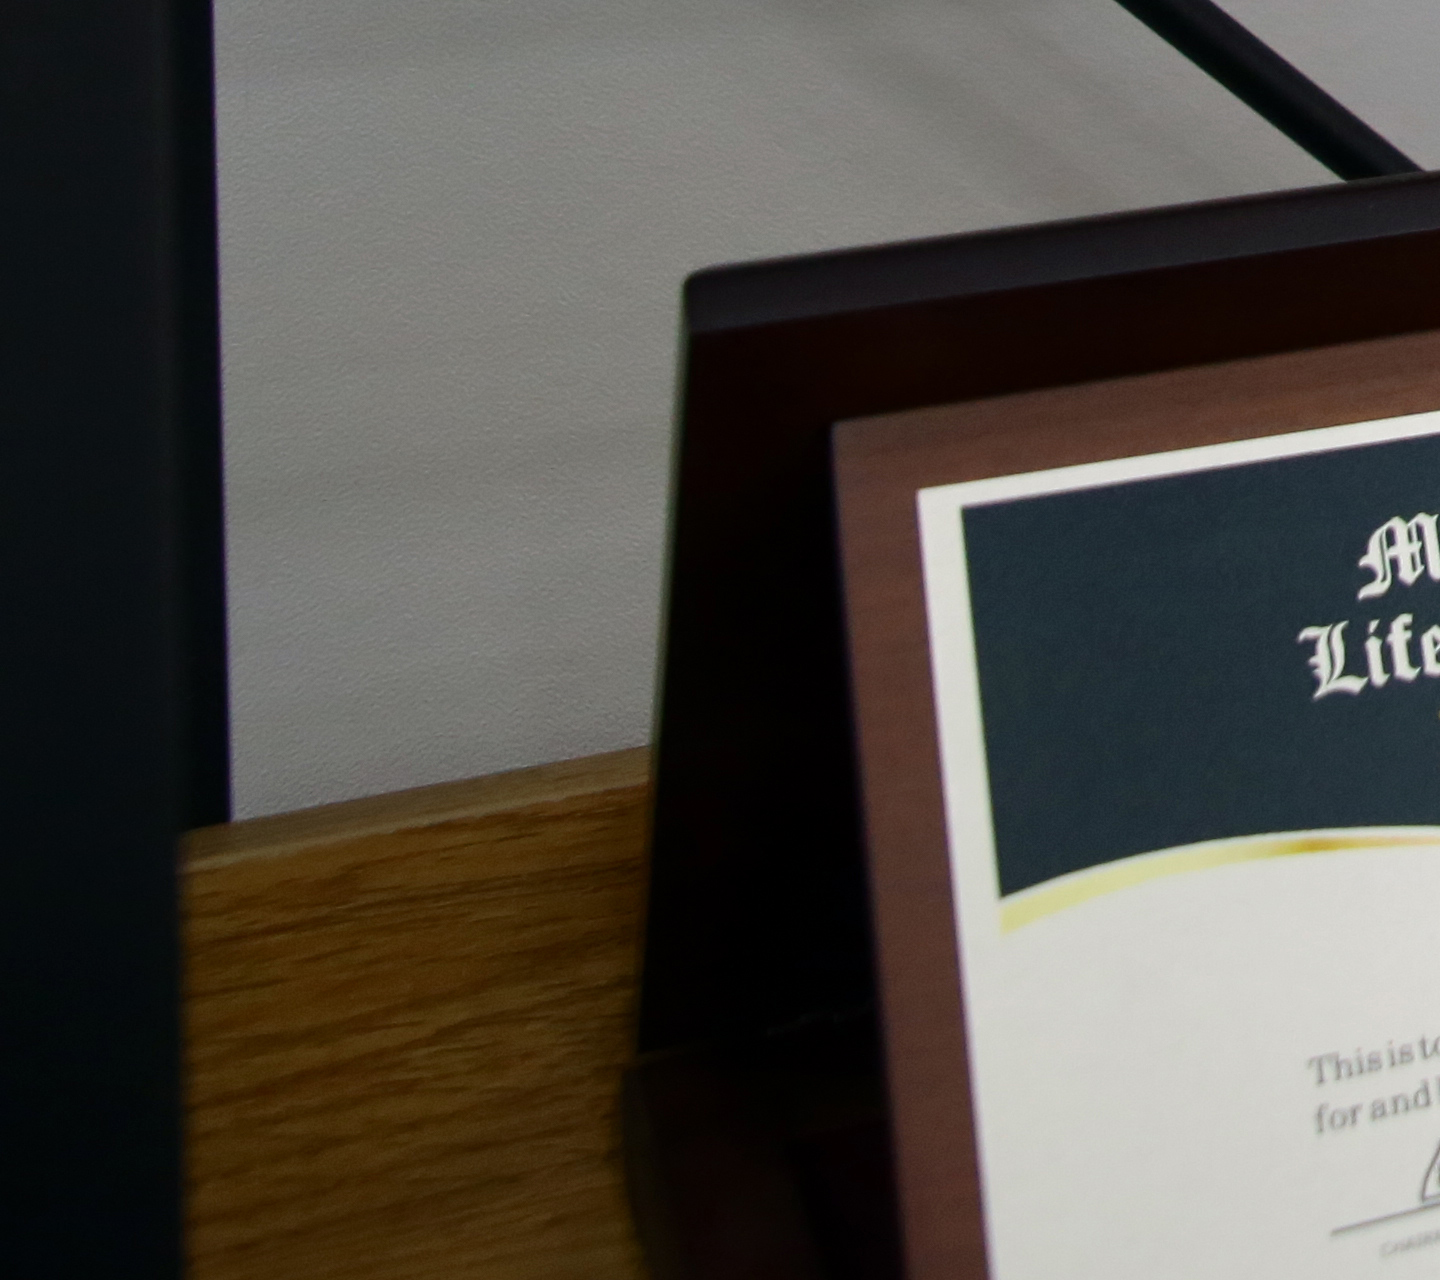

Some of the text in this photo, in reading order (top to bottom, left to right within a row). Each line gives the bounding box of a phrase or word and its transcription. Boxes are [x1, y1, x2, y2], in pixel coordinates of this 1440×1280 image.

[1307, 1047, 1383, 1088] This
[1388, 1040, 1415, 1069] is
[1314, 1103, 1362, 1135] for
[1369, 1079, 1432, 1123] and
